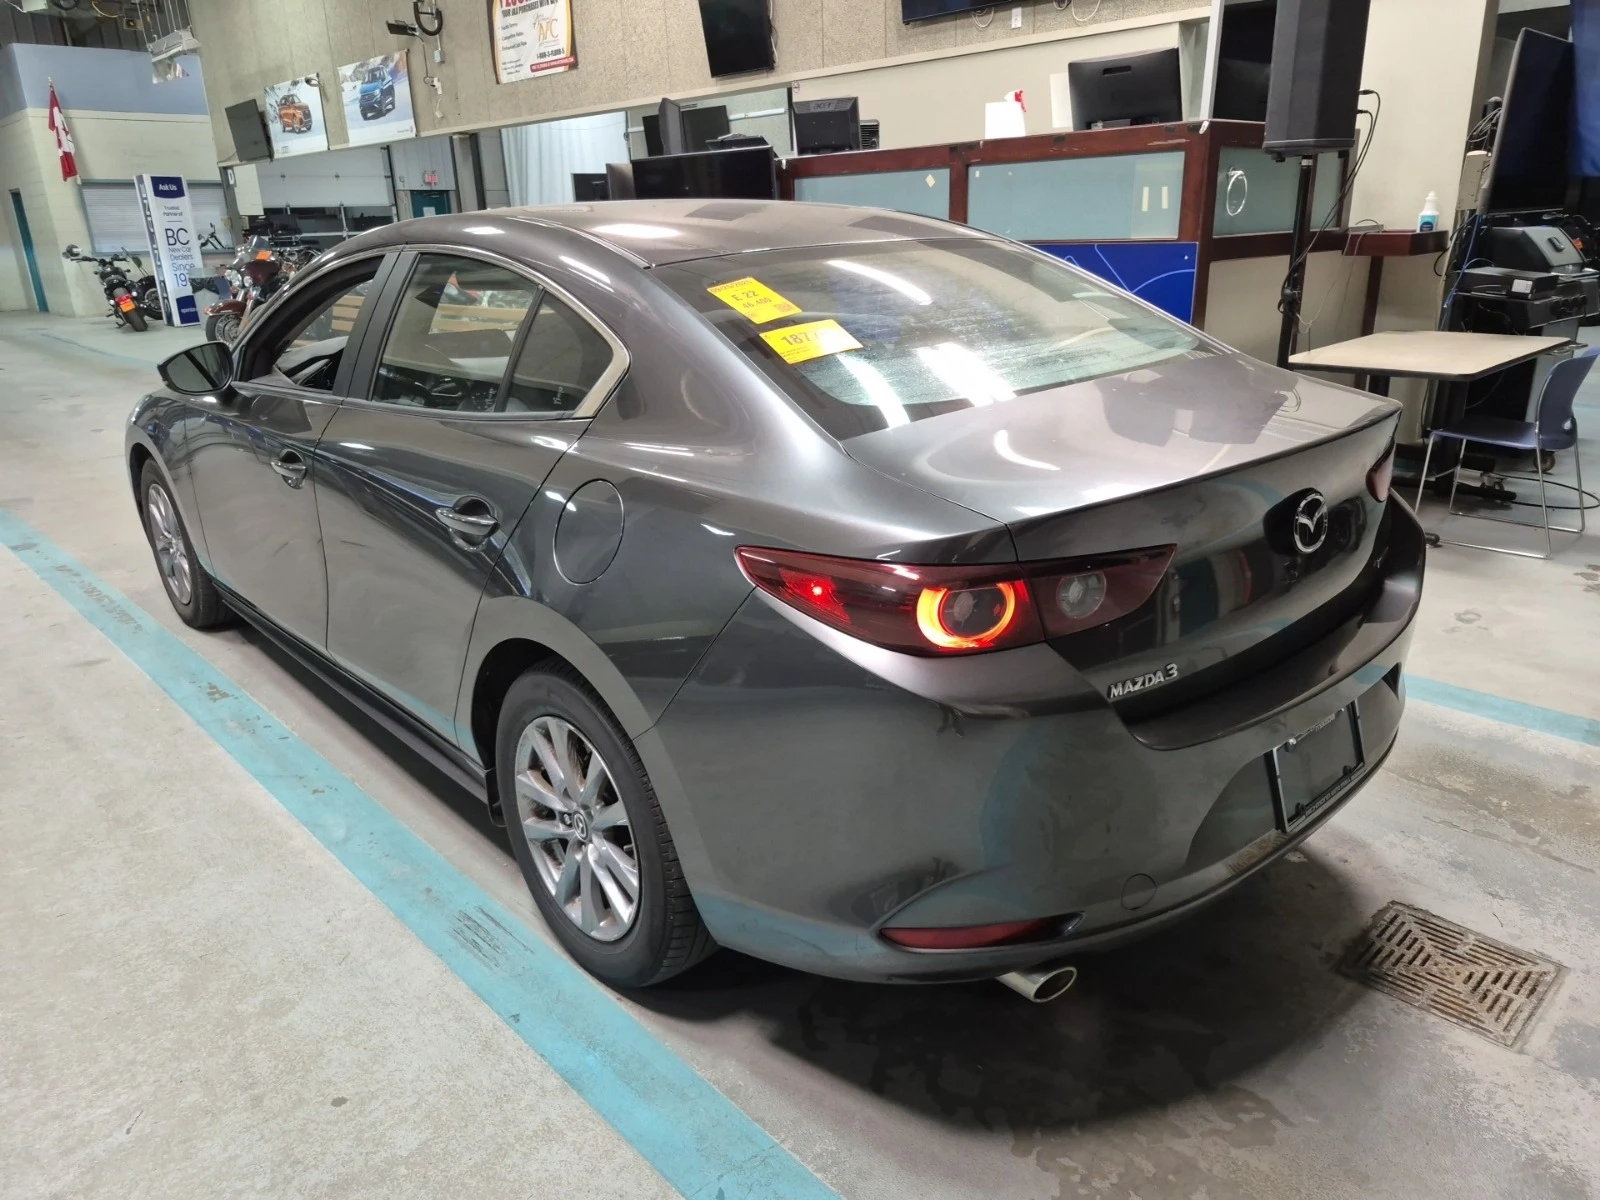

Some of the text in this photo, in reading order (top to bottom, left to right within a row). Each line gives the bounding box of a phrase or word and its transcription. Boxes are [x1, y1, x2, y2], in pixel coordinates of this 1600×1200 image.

[813, 102, 832, 110] acer
[165, 228, 190, 246] BC
[171, 262, 195, 272] Since
